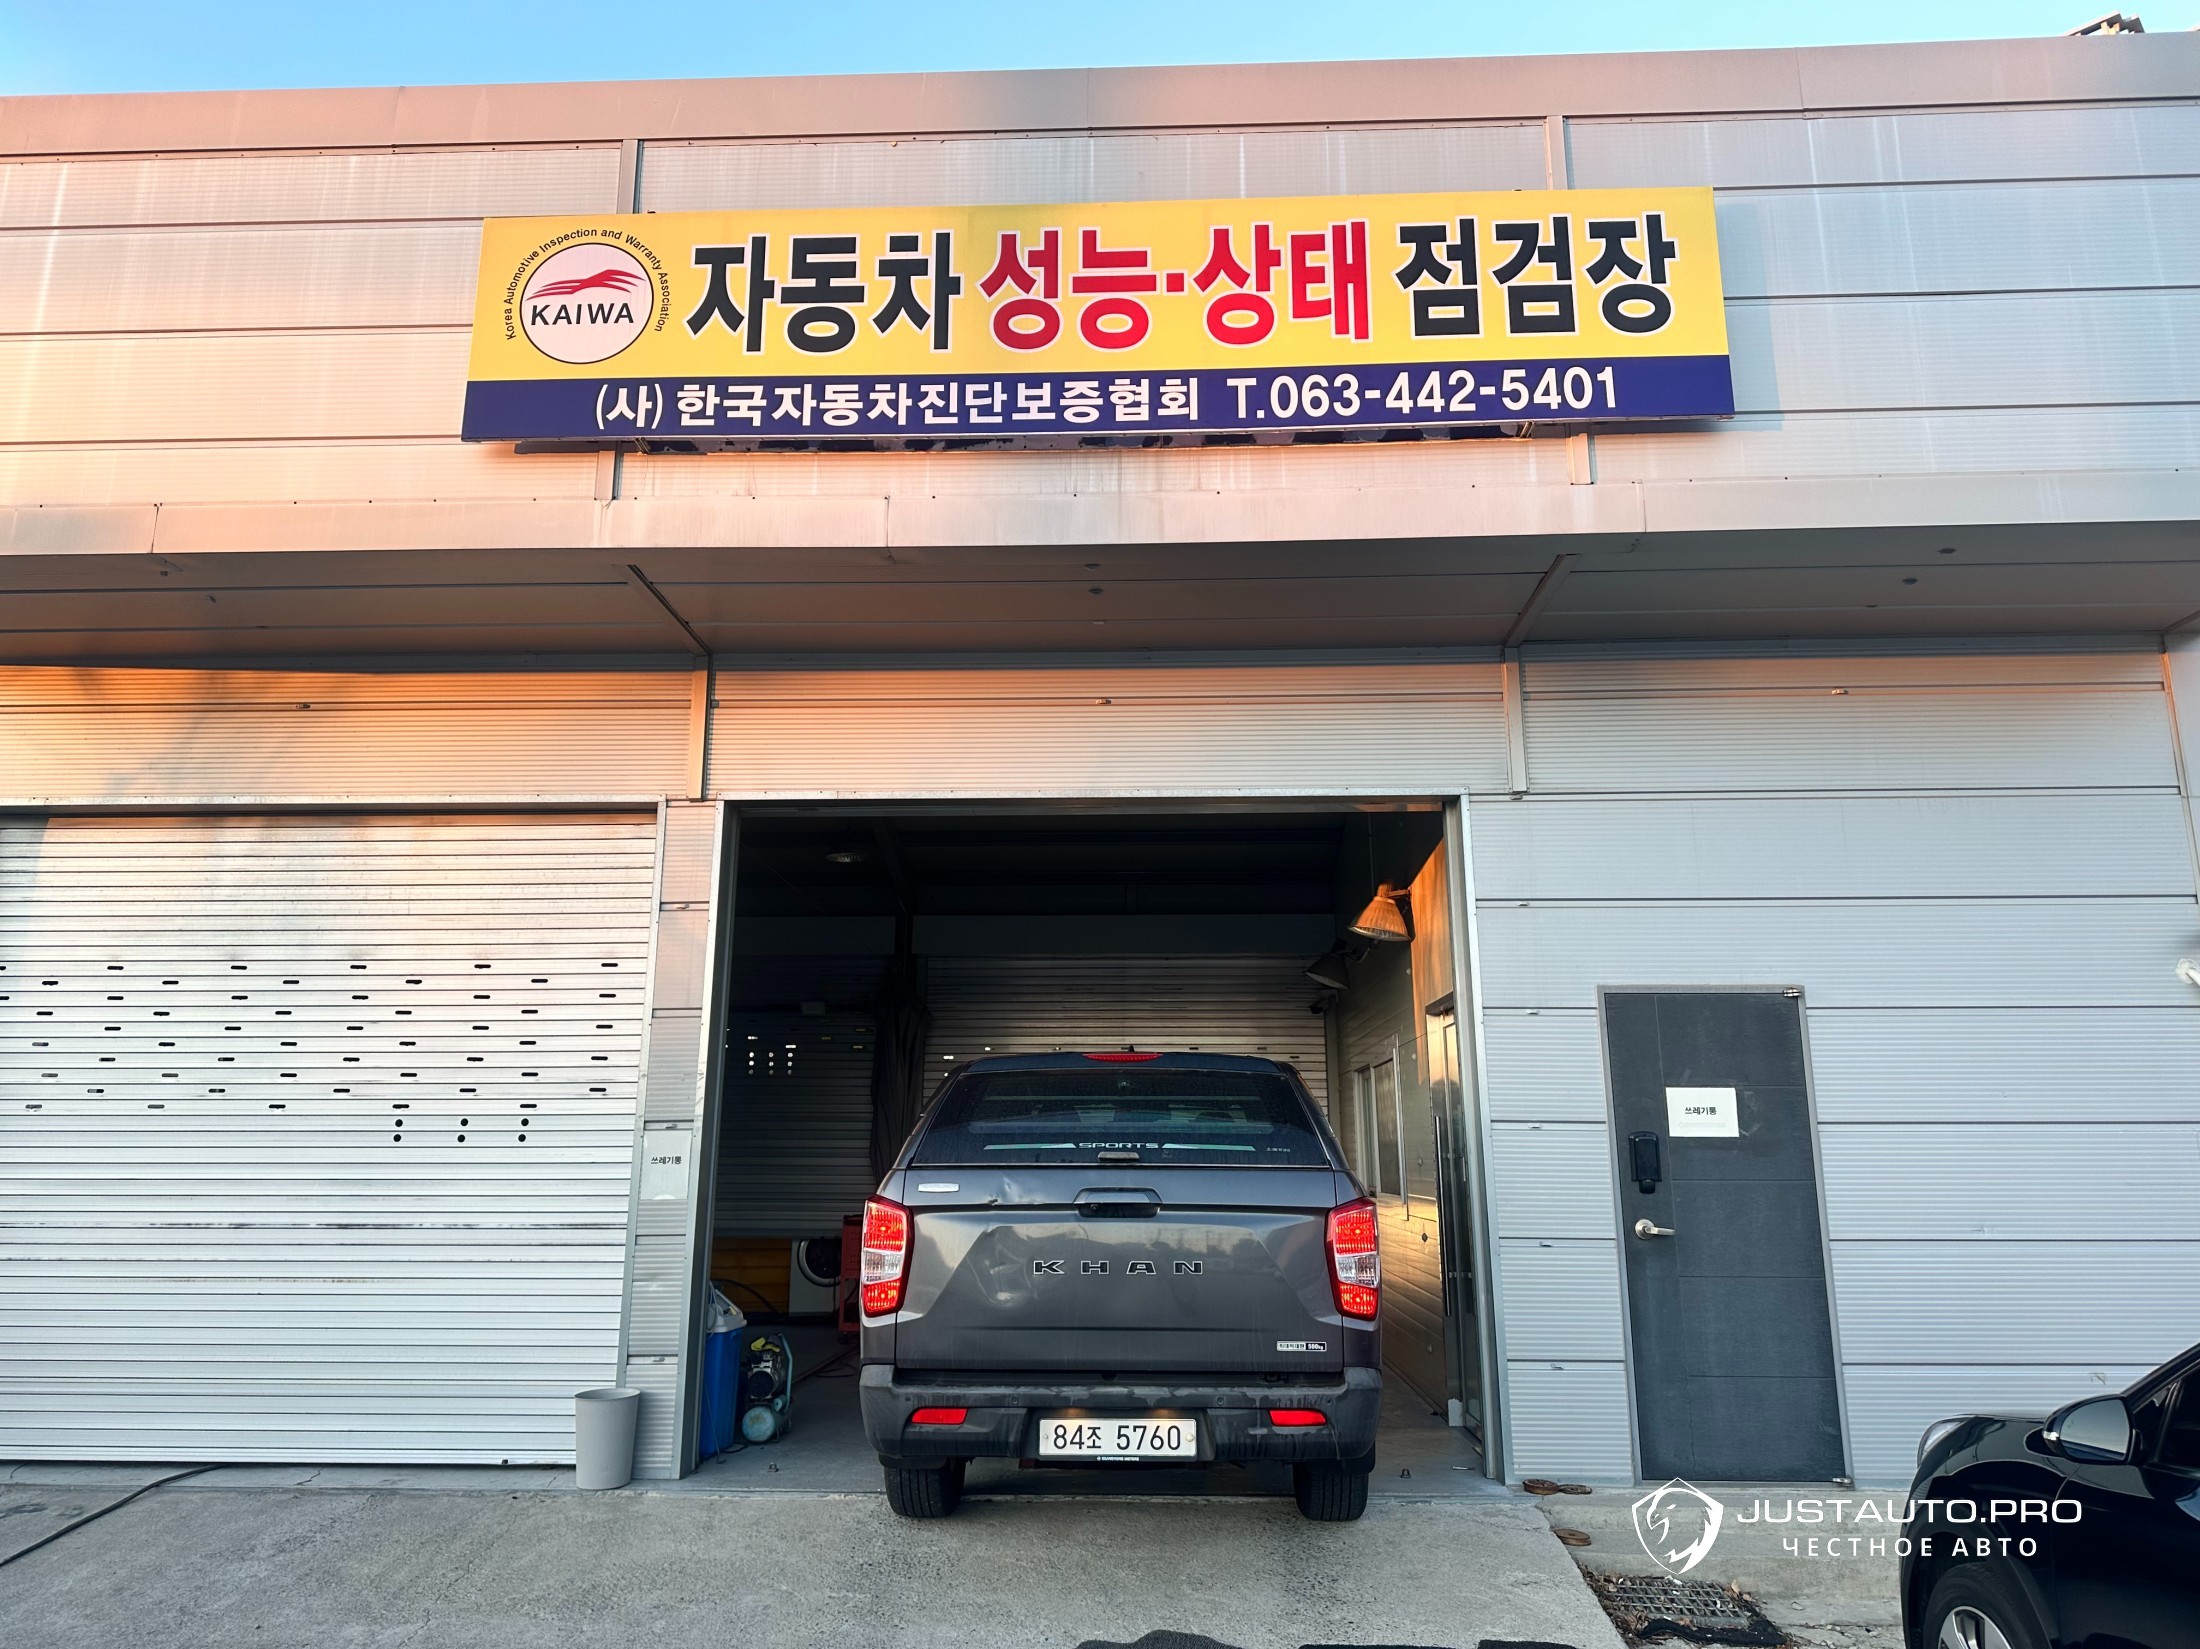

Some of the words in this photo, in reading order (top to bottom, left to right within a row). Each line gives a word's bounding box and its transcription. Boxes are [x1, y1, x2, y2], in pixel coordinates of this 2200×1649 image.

[539, 228, 598, 253] Inspection
[600, 228, 623, 240] and
[625, 234, 662, 271] Warranty
[503, 250, 540, 305] Automotive
[686, 230, 962, 354] 자동차
[979, 220, 1370, 350] 성능·상태
[1395, 212, 1678, 338] 점검장
[530, 302, 634, 326] KAIWA
[654, 272, 672, 333] Association
[503, 308, 517, 341] Korea
[596, 383, 663, 430] (사)
[677, 376, 1200, 428] 한국자동차진단보증협회
[1226, 365, 1619, 420] T.063-442-5401
[1684, 1106, 1717, 1116] 쓰레기통
[1078, 1141, 1159, 1149] SPORTS
[650, 1155, 682, 1165] 쓰레기통
[1033, 1260, 1203, 1275] KHAN
[1053, 1424, 1102, 1450] 84조
[1116, 1424, 1181, 1450] 5760
